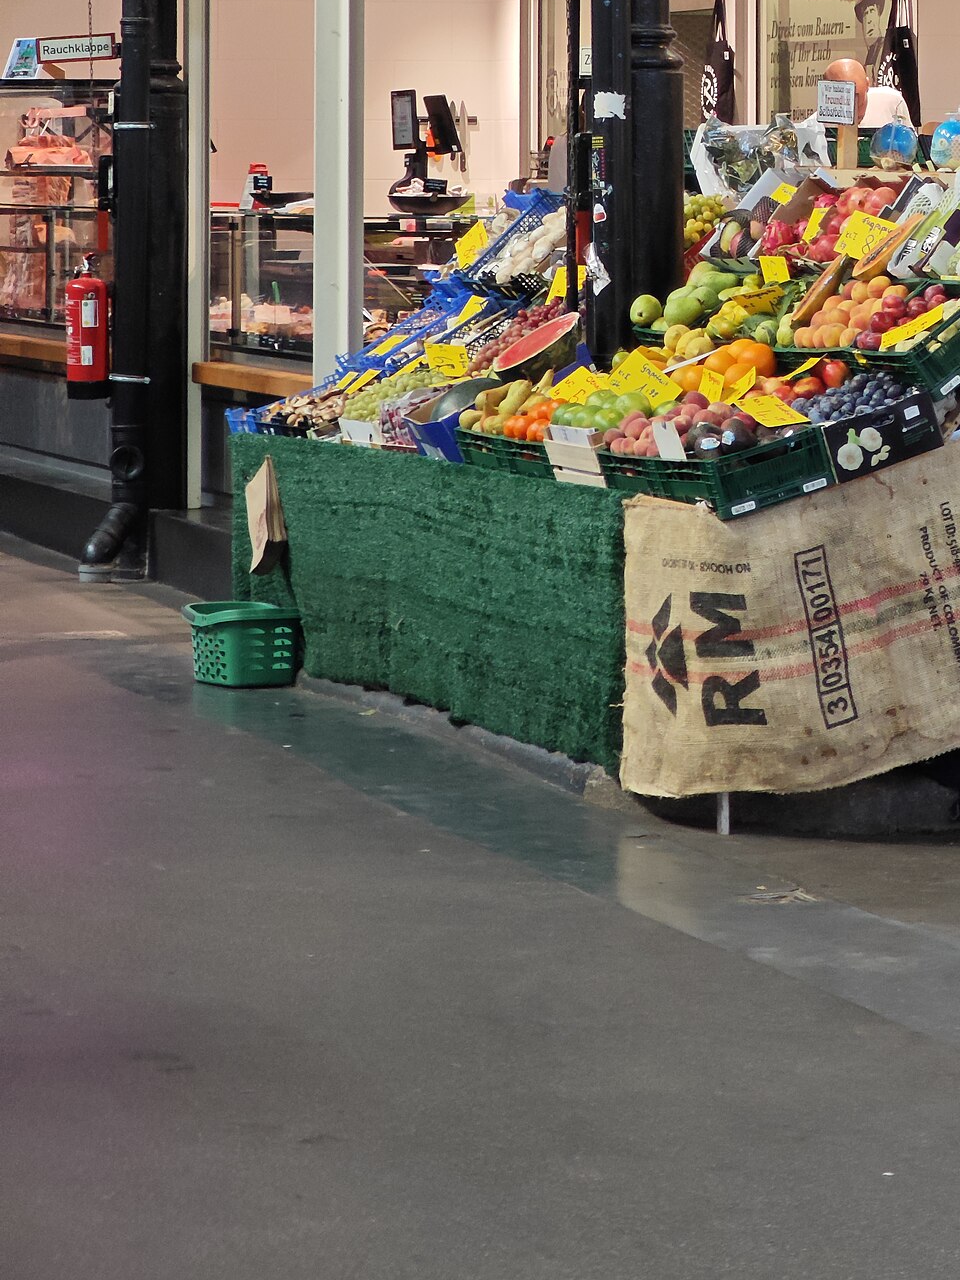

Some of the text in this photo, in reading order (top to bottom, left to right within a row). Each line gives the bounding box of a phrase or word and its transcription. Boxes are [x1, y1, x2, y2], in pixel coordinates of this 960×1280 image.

[816, 17, 844, 36] Bauern
[42, 42, 109, 55] Rauchklappe
[938, 501, 953, 521] LOT
[943, 523, 958, 539] ID:
[917, 525, 943, 582] PRODUCT
[937, 584, 950, 603] OF
[690, 591, 768, 726] RM
